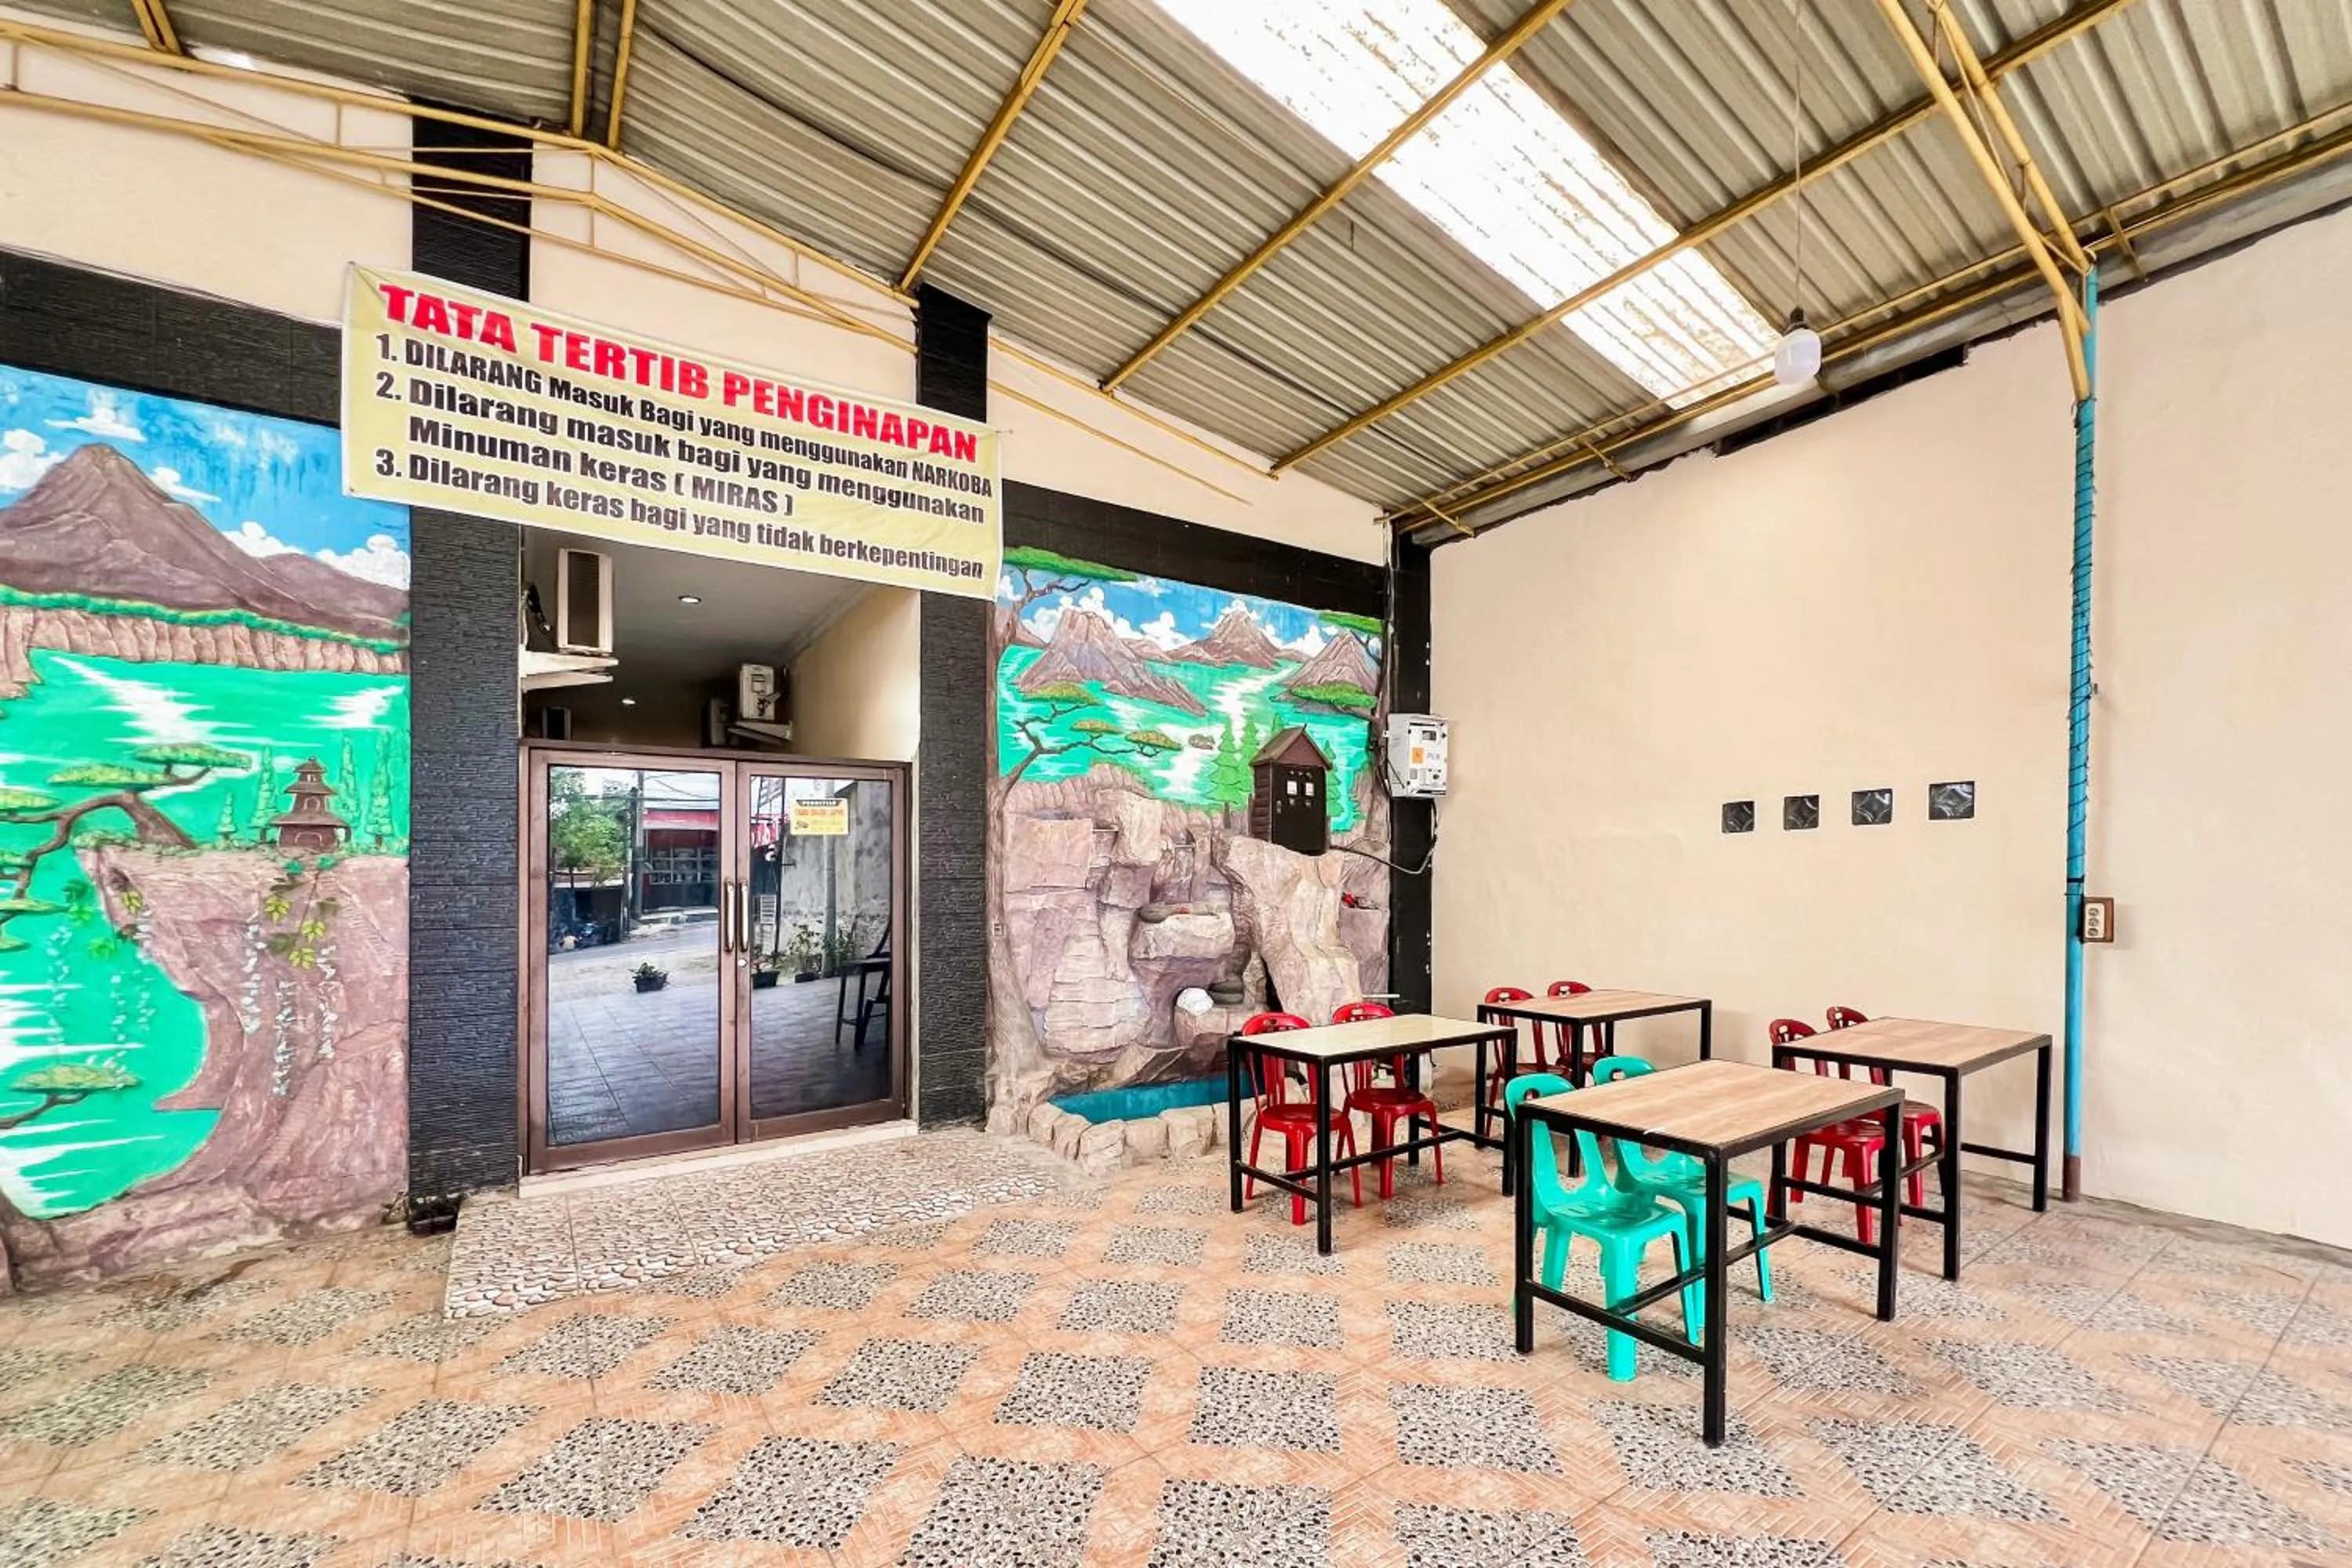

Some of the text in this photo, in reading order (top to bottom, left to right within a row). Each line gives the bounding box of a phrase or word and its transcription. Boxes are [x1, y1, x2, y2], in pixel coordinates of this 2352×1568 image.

[376, 333, 993, 498] 1. DILARANG Masuk Bagi yang menggunakan NARKOBA
[376, 372, 985, 524] 2. Dilarang masuk bagi yang menggunakan
[379, 284, 978, 463] TATA TERTIB PENGINAPAN
[376, 448, 983, 579] 3. Dilarang keras bagi yang tidak berkepentingan
[408, 416, 572, 473] Minuman
[580, 452, 667, 492] keras
[691, 475, 779, 514] MIRAS
